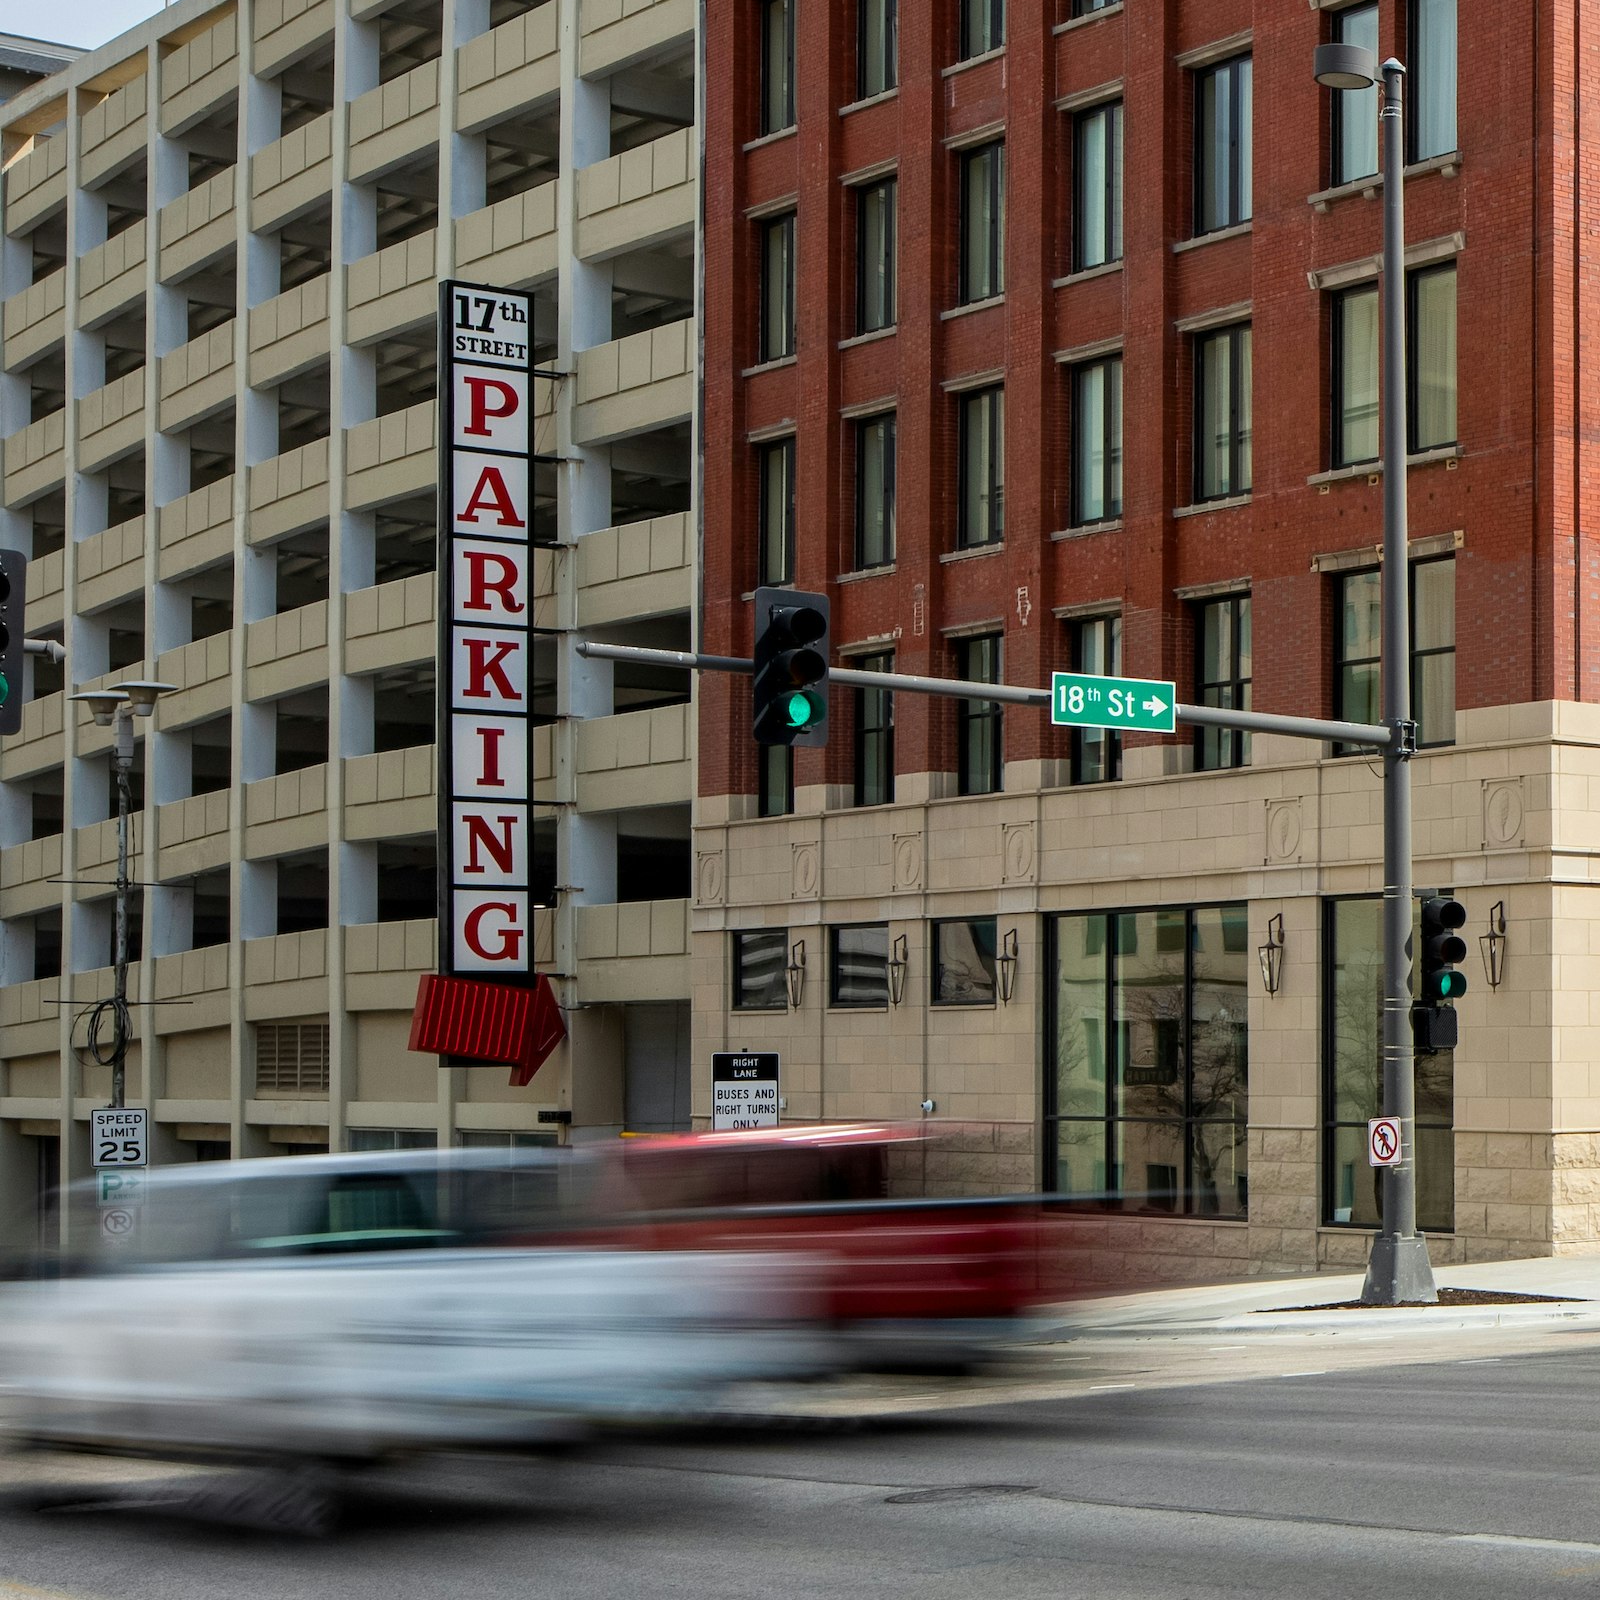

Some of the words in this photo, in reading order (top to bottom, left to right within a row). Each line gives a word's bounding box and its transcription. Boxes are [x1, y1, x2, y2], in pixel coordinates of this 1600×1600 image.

[455, 294, 527, 333] 17th
[455, 335, 527, 360] STREET
[456, 375, 526, 962] PARKING
[1059, 685, 1101, 714] 18th
[1107, 688, 1136, 718] St
[732, 1058, 759, 1067] RIGHT
[734, 1069, 758, 1078] LANE
[717, 1089, 749, 1099] BUSES
[754, 1089, 775, 1099] AND
[716, 1104, 741, 1115] RIGHT
[747, 1104, 776, 1114] TURNS
[97, 1114, 142, 1125] SPEED
[733, 1119, 759, 1130] ONLY
[101, 1127, 137, 1138] LIMIT
[99, 1140, 141, 1162] 25
